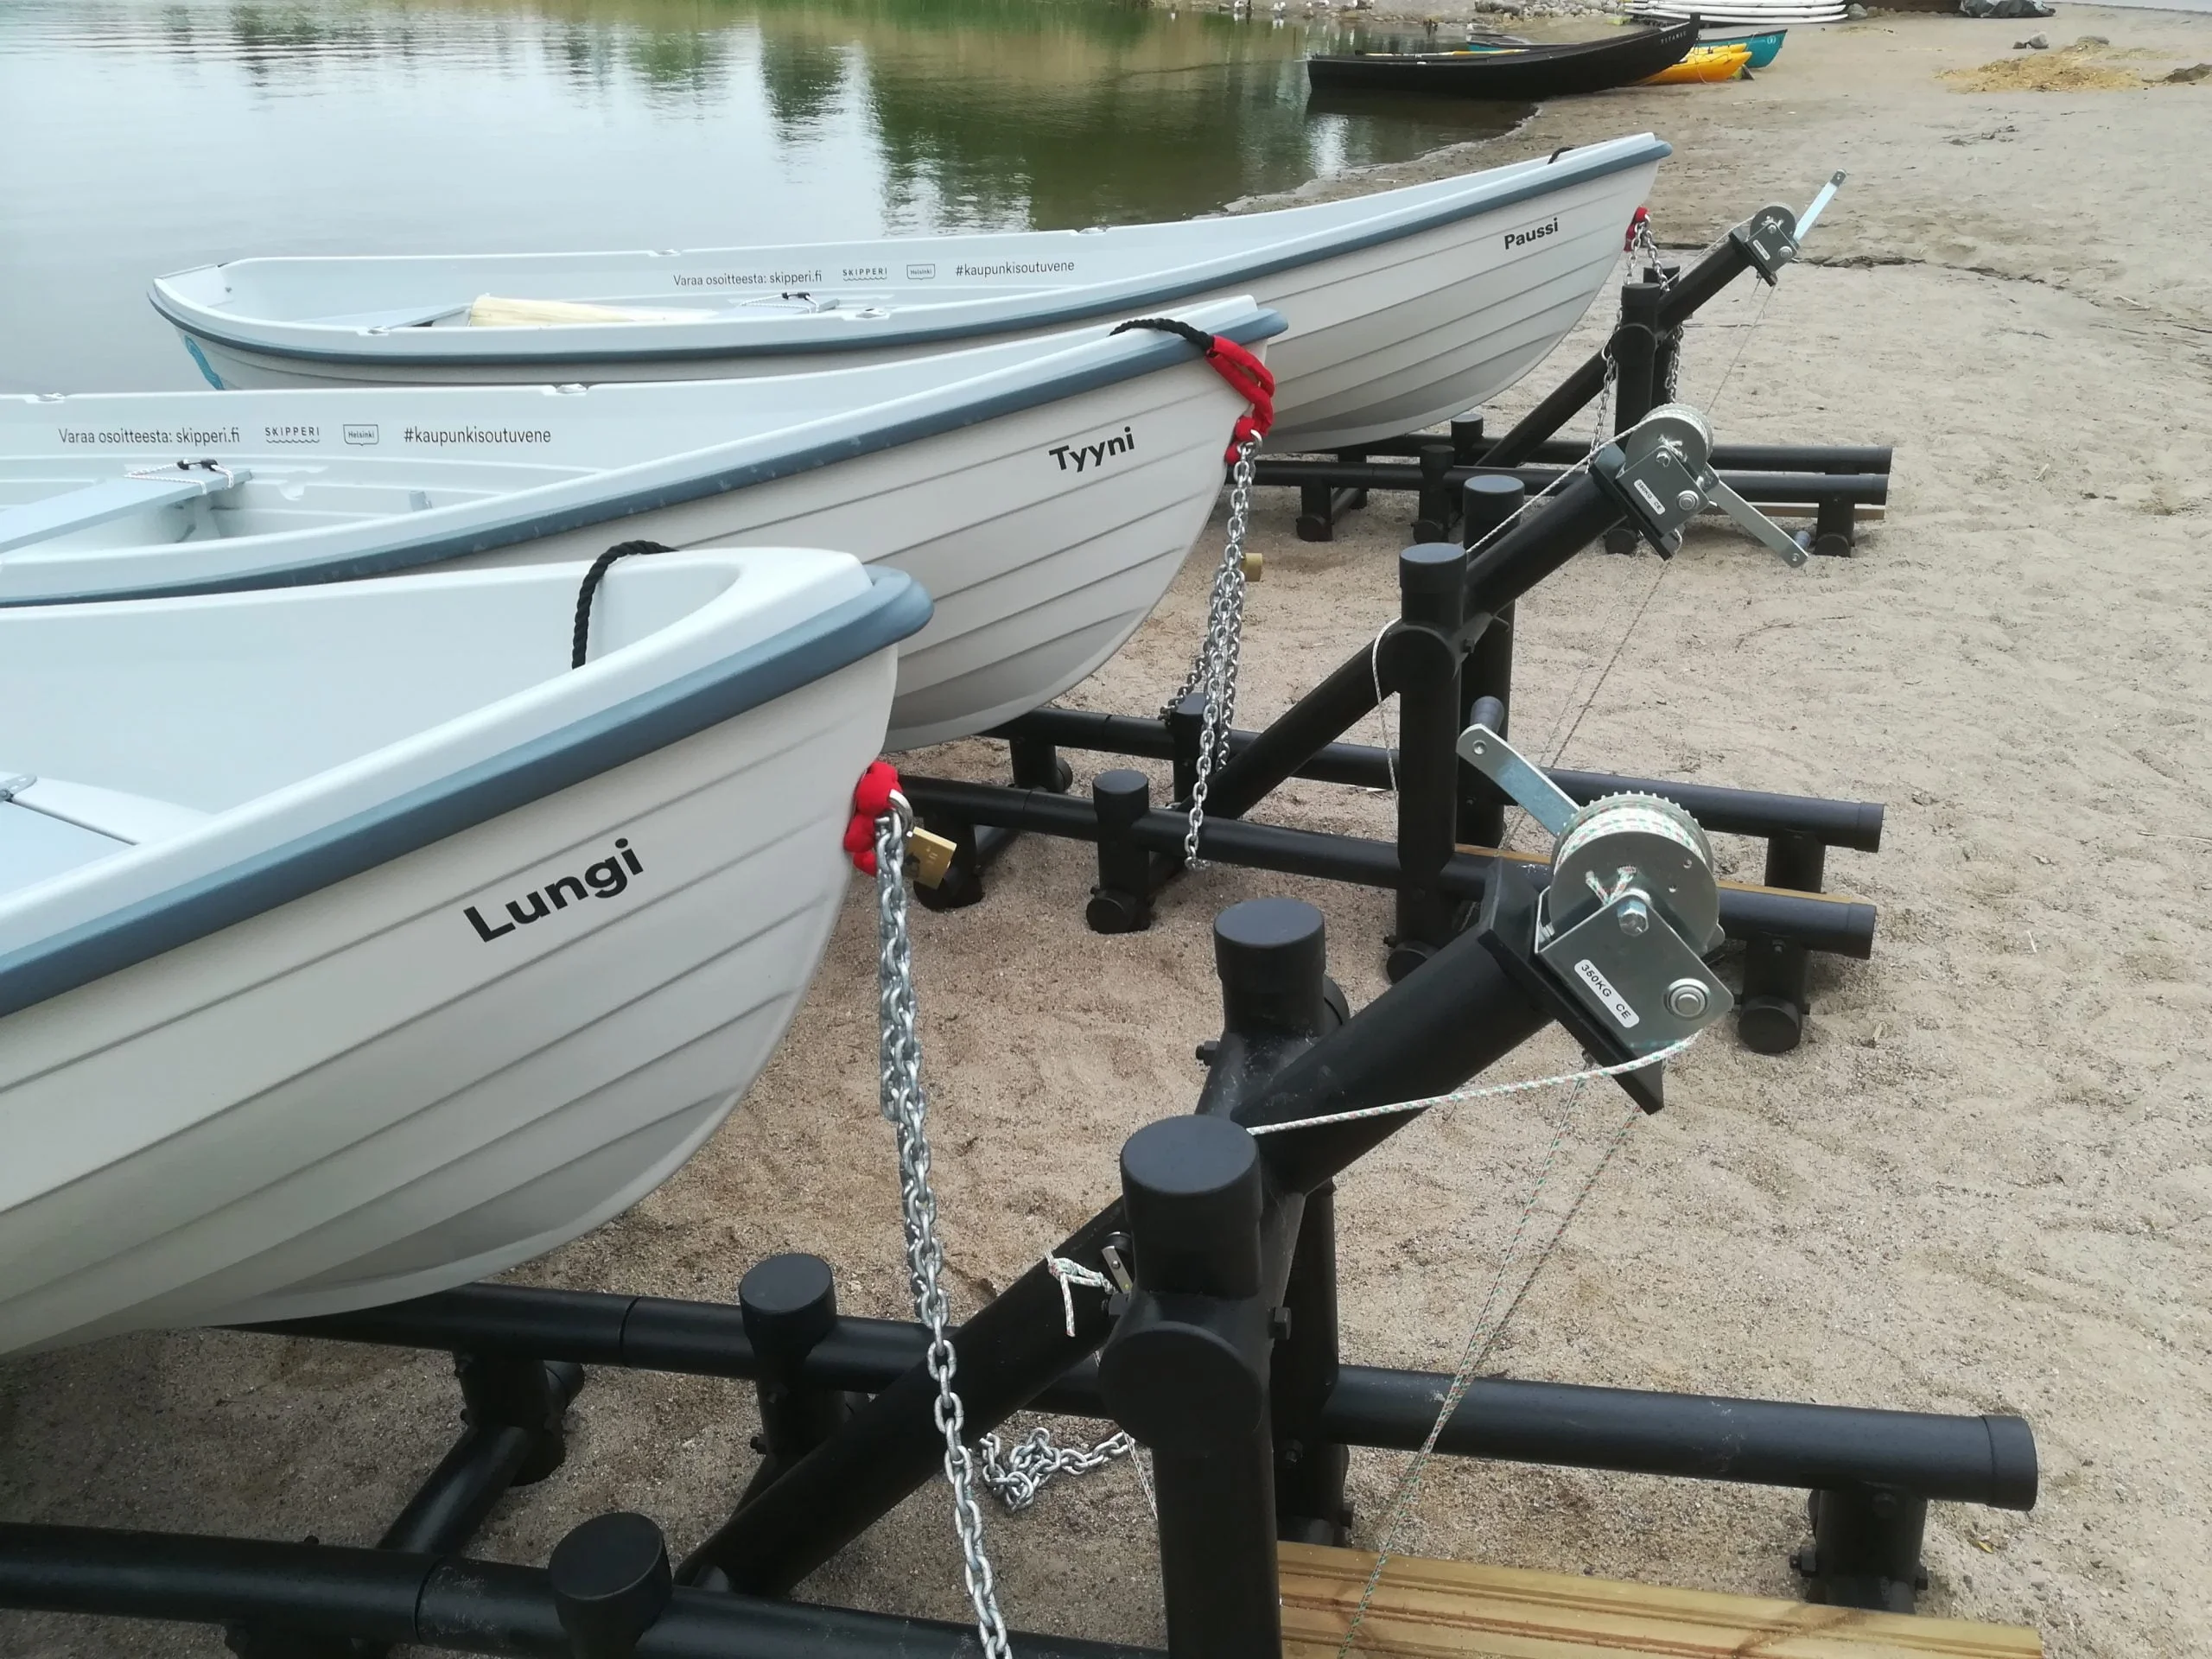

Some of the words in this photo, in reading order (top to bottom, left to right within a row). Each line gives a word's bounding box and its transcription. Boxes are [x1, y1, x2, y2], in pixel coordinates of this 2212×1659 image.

[1504, 217, 1559, 250] Paussi
[673, 274, 703, 286] Varaa
[706, 272, 767, 285] osoitteesta:
[770, 270, 822, 286] skipperi.fi
[842, 267, 887, 276] SKIPPERI
[956, 262, 1075, 277] #kaupunkisoutuvene
[58, 428, 95, 443] Varaa
[99, 427, 173, 443] osoitteesta:
[176, 427, 240, 447] skipperi.fi
[264, 426, 320, 436] SKIPPERI
[404, 426, 551, 447] #kaupunkisoutuvene
[1048, 426, 1135, 473] Tyyni
[463, 838, 644, 943] Lungi
[1581, 963, 1611, 997] 350KG
[1616, 1003, 1631, 1019] CE
